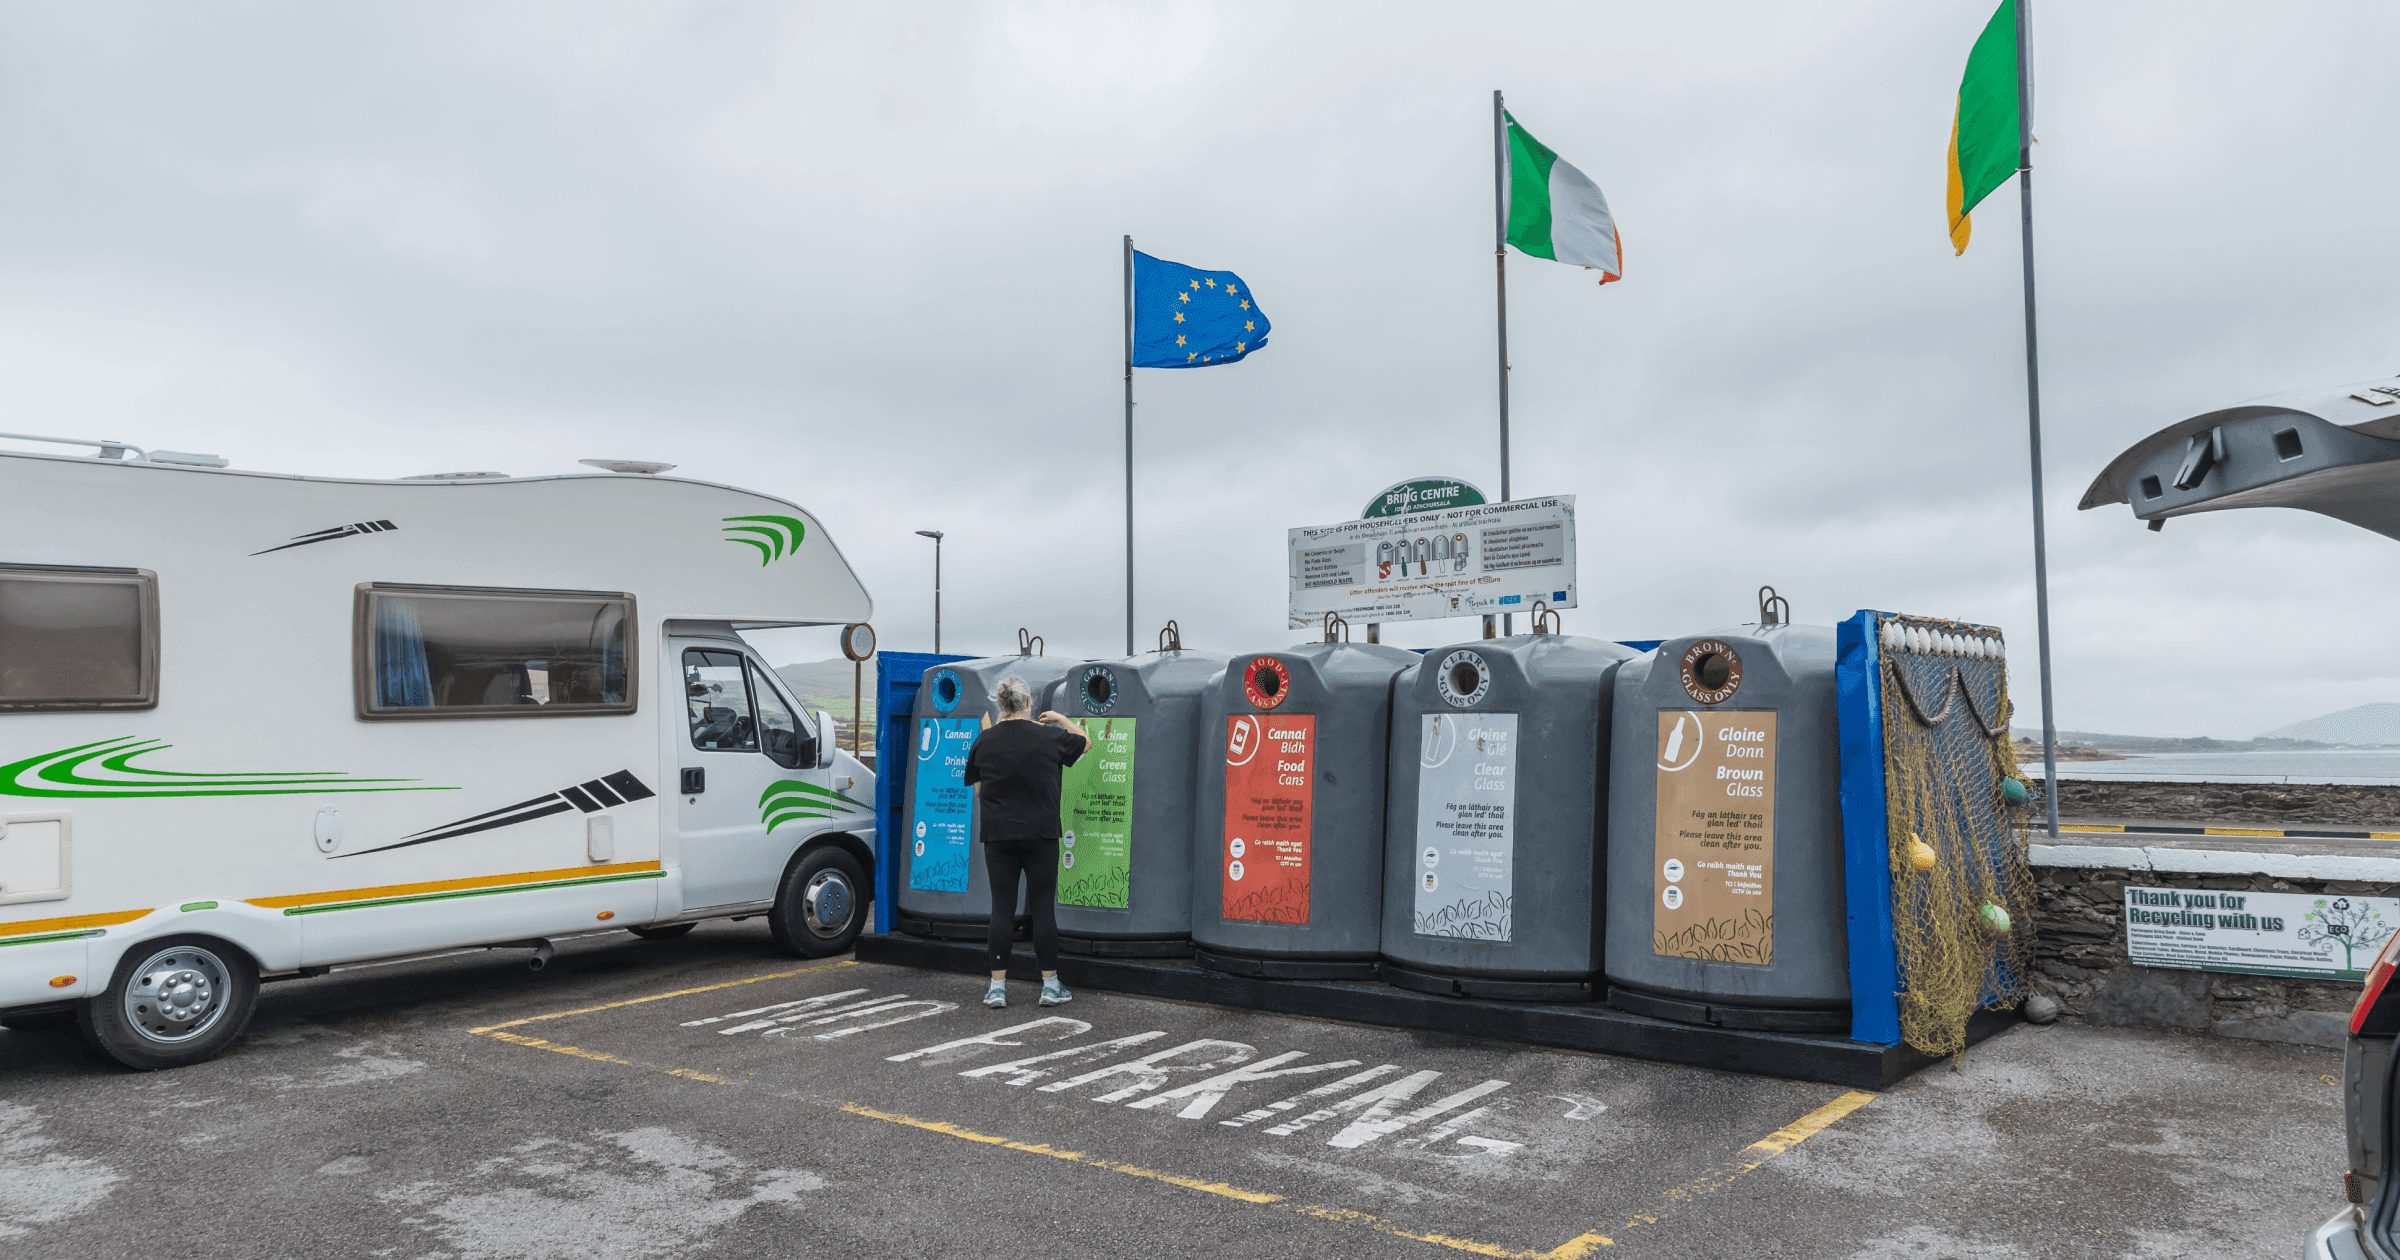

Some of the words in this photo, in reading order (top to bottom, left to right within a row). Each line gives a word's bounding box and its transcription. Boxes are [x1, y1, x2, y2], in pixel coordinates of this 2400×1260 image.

[1387, 491, 1417, 504] BRING
[1421, 486, 1459, 500] CENTRE
[1420, 514, 1440, 522] ONLY
[1447, 511, 1463, 519] NOT
[1465, 509, 1481, 517] FOR
[1483, 502, 1539, 515] COMMERCIAL
[1541, 500, 1558, 508] USE
[1685, 642, 1735, 664] BROWN
[1250, 659, 1282, 671] FOOD
[1443, 652, 1482, 670] CLEAR
[1084, 668, 1114, 682] GREEN
[1440, 682, 1464, 706] GLASS
[1468, 677, 1488, 704] ONLY
[1682, 674, 1711, 702] GLASS
[1715, 671, 1740, 701] ONLY
[1247, 688, 1268, 707] CANS
[1272, 680, 1288, 705] ONLY
[1081, 691, 1099, 713] GLASS
[1101, 690, 1117, 712] ONLY
[1098, 730, 1128, 740] Goine
[1268, 728, 1307, 740] Cannaí
[1468, 728, 1507, 741] Gloine
[1718, 727, 1765, 742] Gloine
[1107, 743, 1127, 753] Glas
[1281, 741, 1305, 753] Bídh
[1487, 743, 1507, 755] Glé
[1726, 743, 1764, 758] Donn
[1099, 759, 1126, 770] Green
[1277, 760, 1305, 772] Food
[1474, 762, 1506, 775] Clear
[1103, 771, 1126, 782] Glass
[1716, 765, 1763, 781] Brown
[1279, 774, 1304, 786] Cans
[1474, 777, 1505, 790] Glass
[1726, 782, 1763, 797] Glass
[1458, 811, 1472, 819] glan
[1692, 810, 1705, 819] Fág
[1720, 811, 1747, 820] láthair
[1474, 822, 1486, 830] this
[1707, 819, 1724, 828] glan
[1744, 820, 1763, 828] thoil
[1453, 829, 1469, 837] clean
[1471, 830, 1487, 838] after
[1679, 830, 1702, 838] Please
[1704, 831, 1724, 839] leave
[1727, 832, 1741, 840] this
[1700, 839, 1720, 848] clean
[1722, 840, 1741, 850] after
[1707, 861, 1723, 869] raibh
[1725, 862, 1744, 870] maith
[1727, 870, 1748, 878] Thank
[1749, 870, 1762, 878] You
[2128, 888, 2182, 907] Thank
[2184, 893, 2217, 909] you
[2219, 893, 2246, 910] for
[2129, 907, 2215, 930] Recycling
[2218, 913, 2257, 930] with
[2261, 916, 2285, 931] us
[679, 988, 960, 1040] NO
